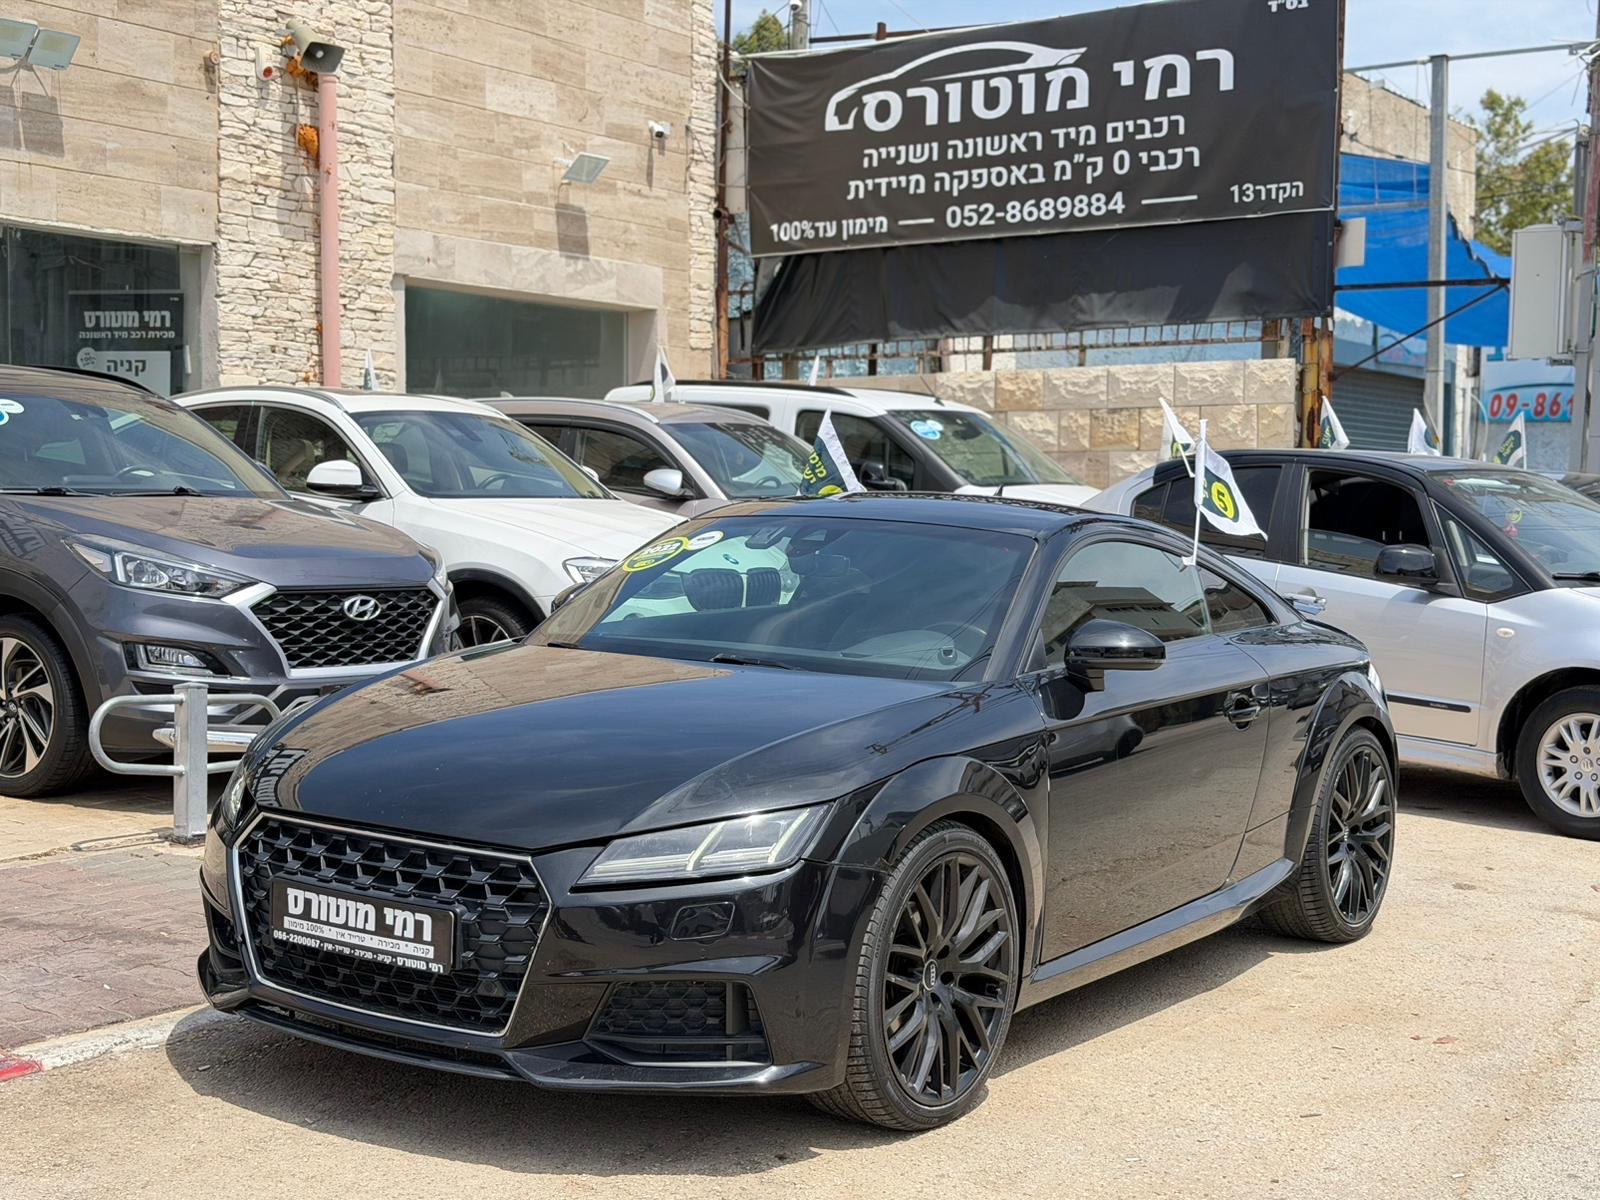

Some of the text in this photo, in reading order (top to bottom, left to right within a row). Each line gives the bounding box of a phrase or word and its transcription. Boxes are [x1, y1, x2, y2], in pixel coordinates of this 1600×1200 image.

[861, 48, 1236, 132] רמי מוטורס
[862, 114, 1186, 169] רכבים מיד ראשונה ושנייה
[1112, 149, 1132, 175] 0
[1137, 145, 1201, 172] רכבי
[846, 173, 926, 201] מיידית
[933, 162, 1047, 197] באספקה
[945, 191, 1127, 229] 052-8689884
[841, 215, 888, 241] מימון
[83, 310, 171, 329] רמי מוטורס
[129, 331, 147, 339] רכב
[147, 331, 176, 339] מכירת
[106, 359, 147, 377] קניה
[286, 887, 434, 943] רמי מוטורס
[306, 922, 325, 935] 100%
[377, 939, 401, 951] מכירה
[396, 956, 427, 971] מוטורס
[428, 962, 444, 974] רמי
